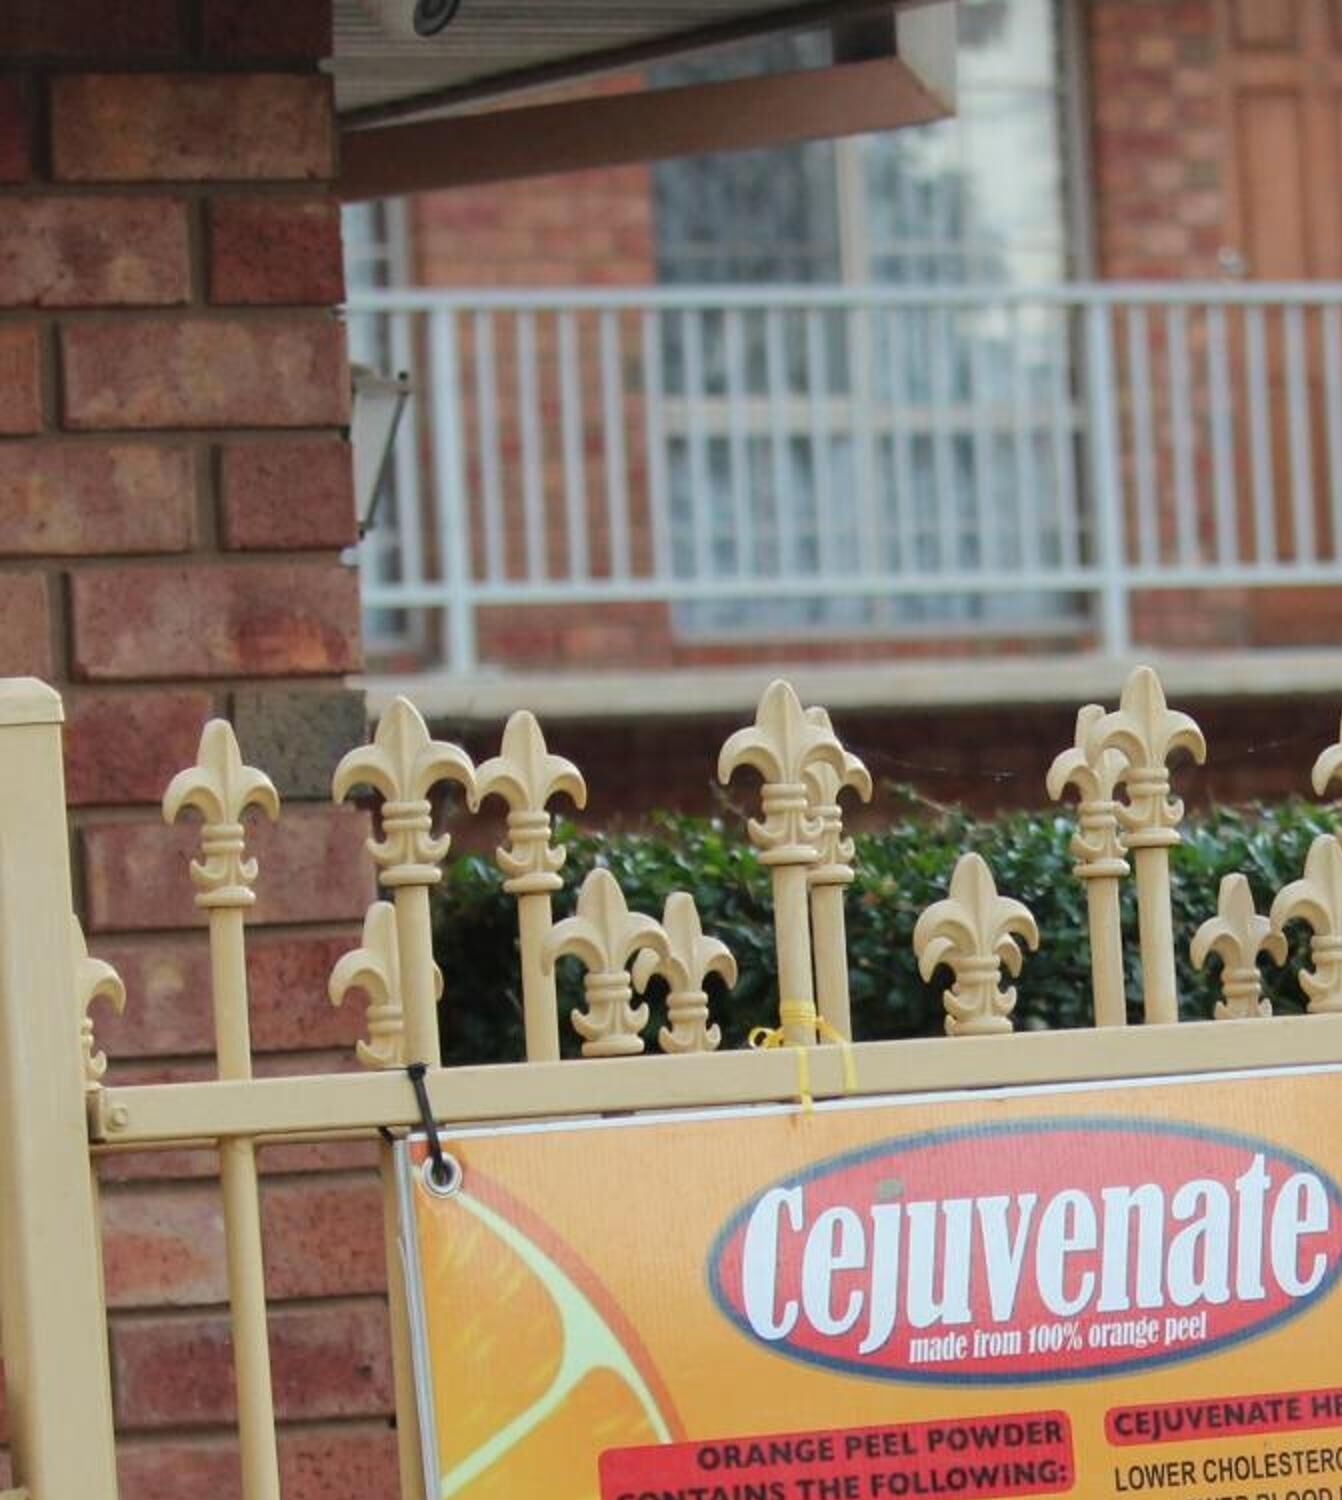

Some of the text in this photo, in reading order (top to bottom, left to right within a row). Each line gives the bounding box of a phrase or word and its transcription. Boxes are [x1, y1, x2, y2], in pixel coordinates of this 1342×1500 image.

[742, 1153, 1330, 1355] Cejuvenate
[908, 1312, 1207, 1363] made from 100% orange peel
[1114, 1400, 1301, 1440] CEJUVENATE
[697, 1419, 1064, 1470] ORANGE PEEL POWDER
[871, 1460, 1067, 1498] FOLLOWING:
[1114, 1461, 1197, 1492] LOWER
